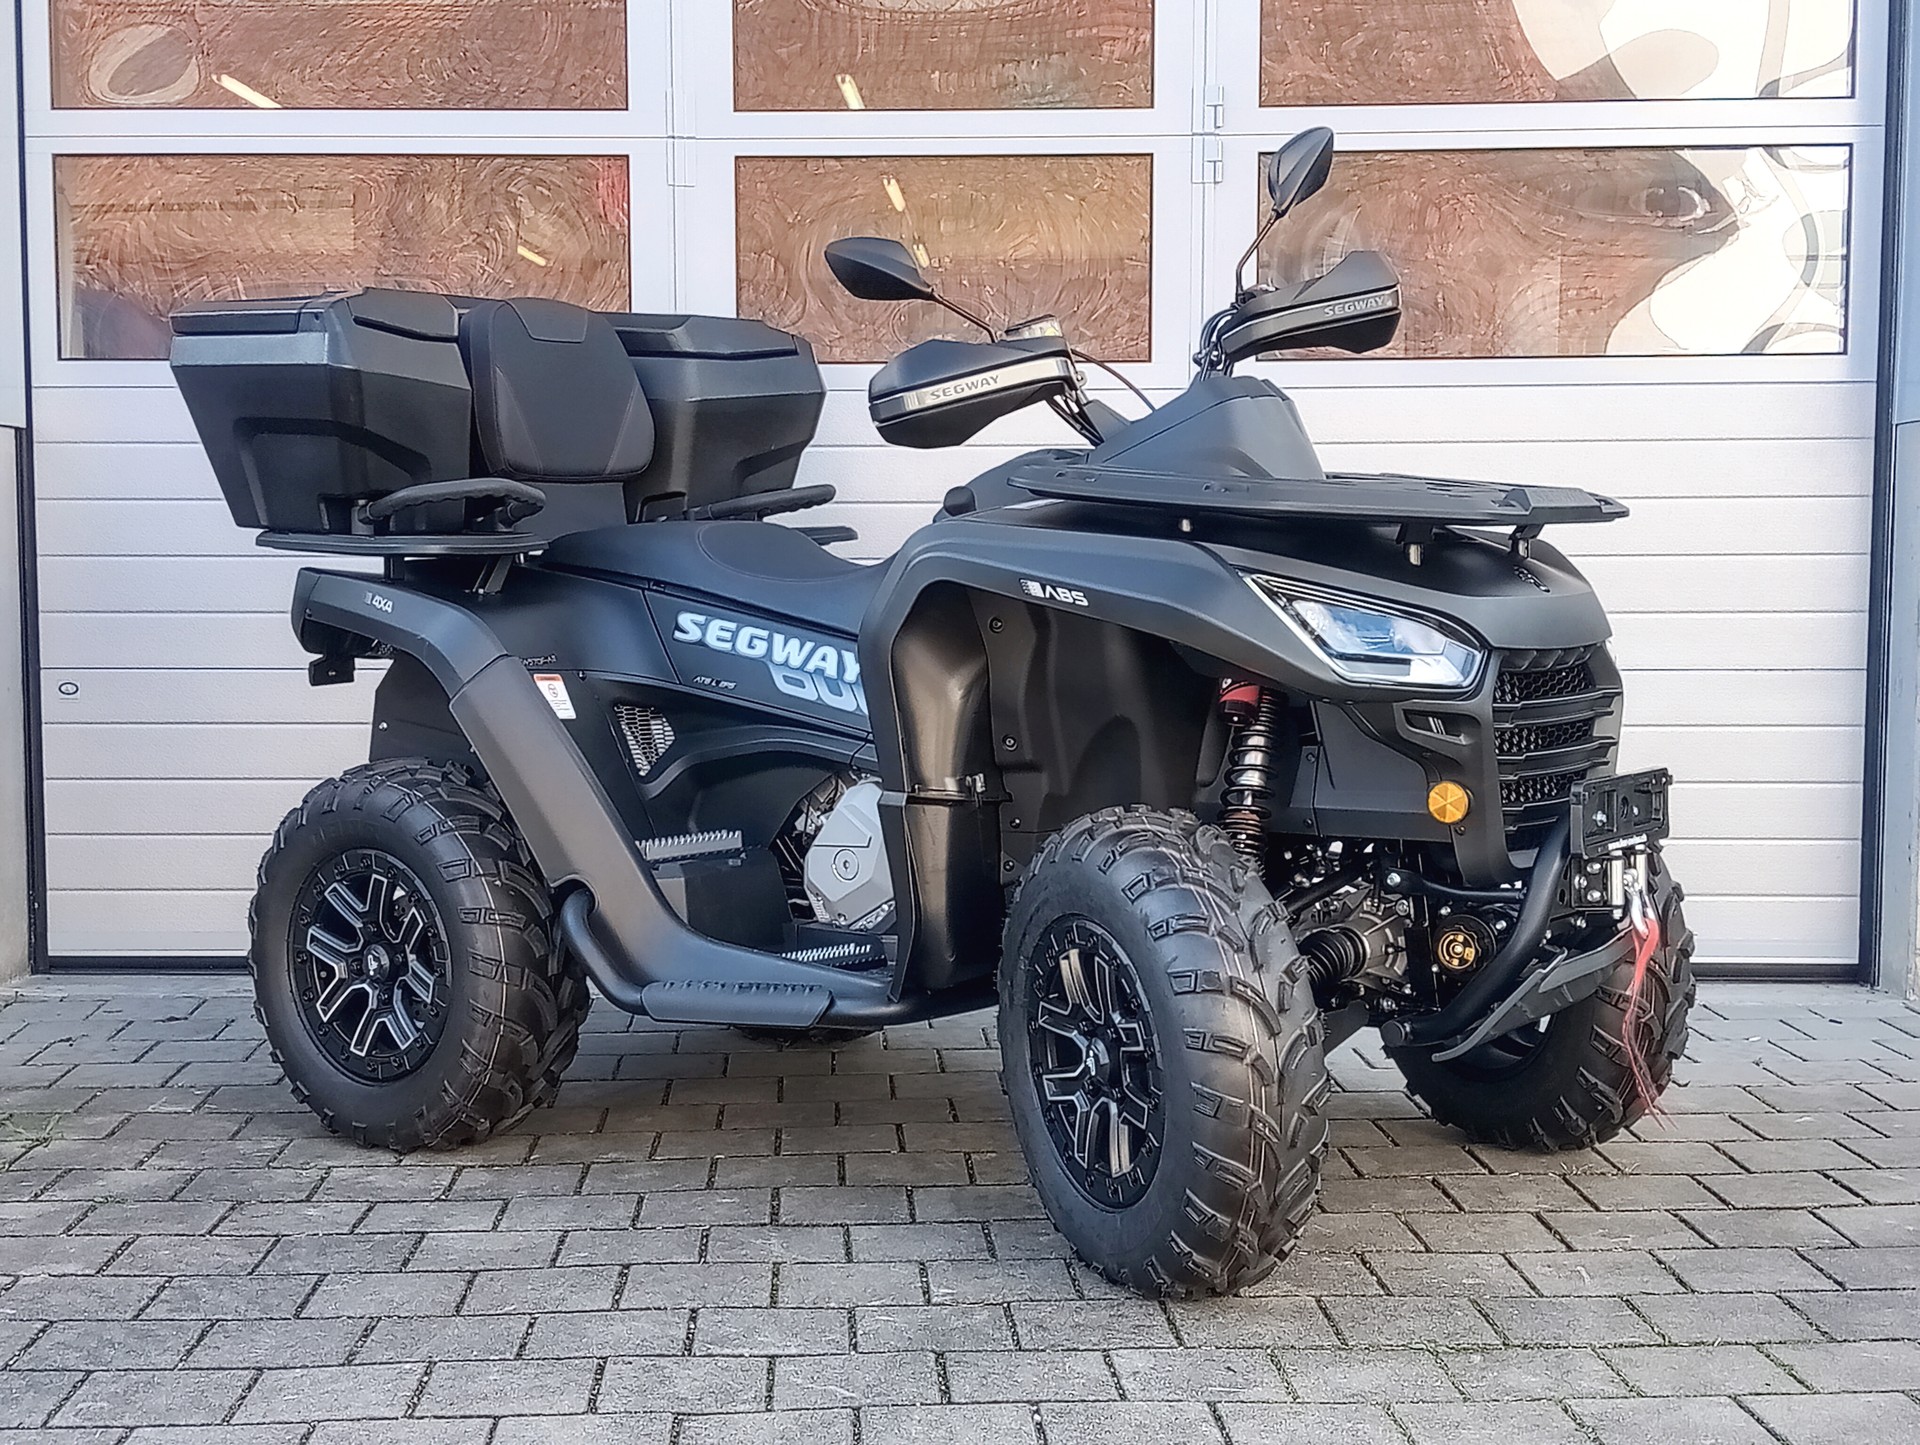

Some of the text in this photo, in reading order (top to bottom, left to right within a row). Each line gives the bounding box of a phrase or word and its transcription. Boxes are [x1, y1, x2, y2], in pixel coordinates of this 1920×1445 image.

[1323, 296, 1384, 317] SEGWAY
[929, 375, 999, 401] SEGWAY
[1045, 584, 1089, 606] ABS
[673, 611, 861, 684] SEGWAY
